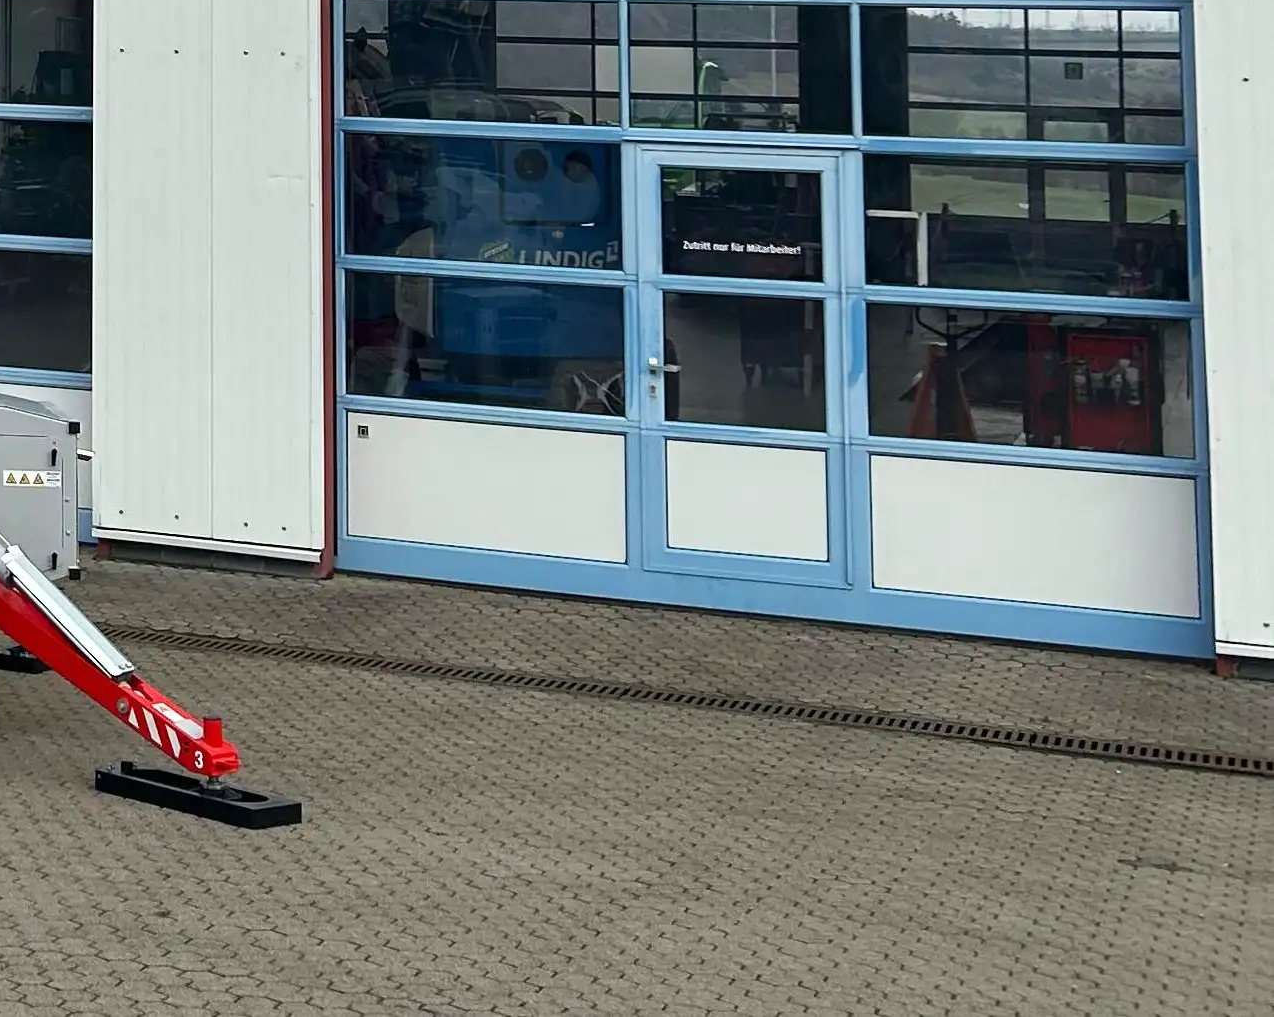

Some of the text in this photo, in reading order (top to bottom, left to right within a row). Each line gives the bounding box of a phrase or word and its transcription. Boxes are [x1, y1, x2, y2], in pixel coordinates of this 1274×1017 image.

[683, 240, 712, 251] Zutritt
[713, 243, 729, 252] nur
[730, 242, 745, 252] für
[194, 750, 204, 769] 3
